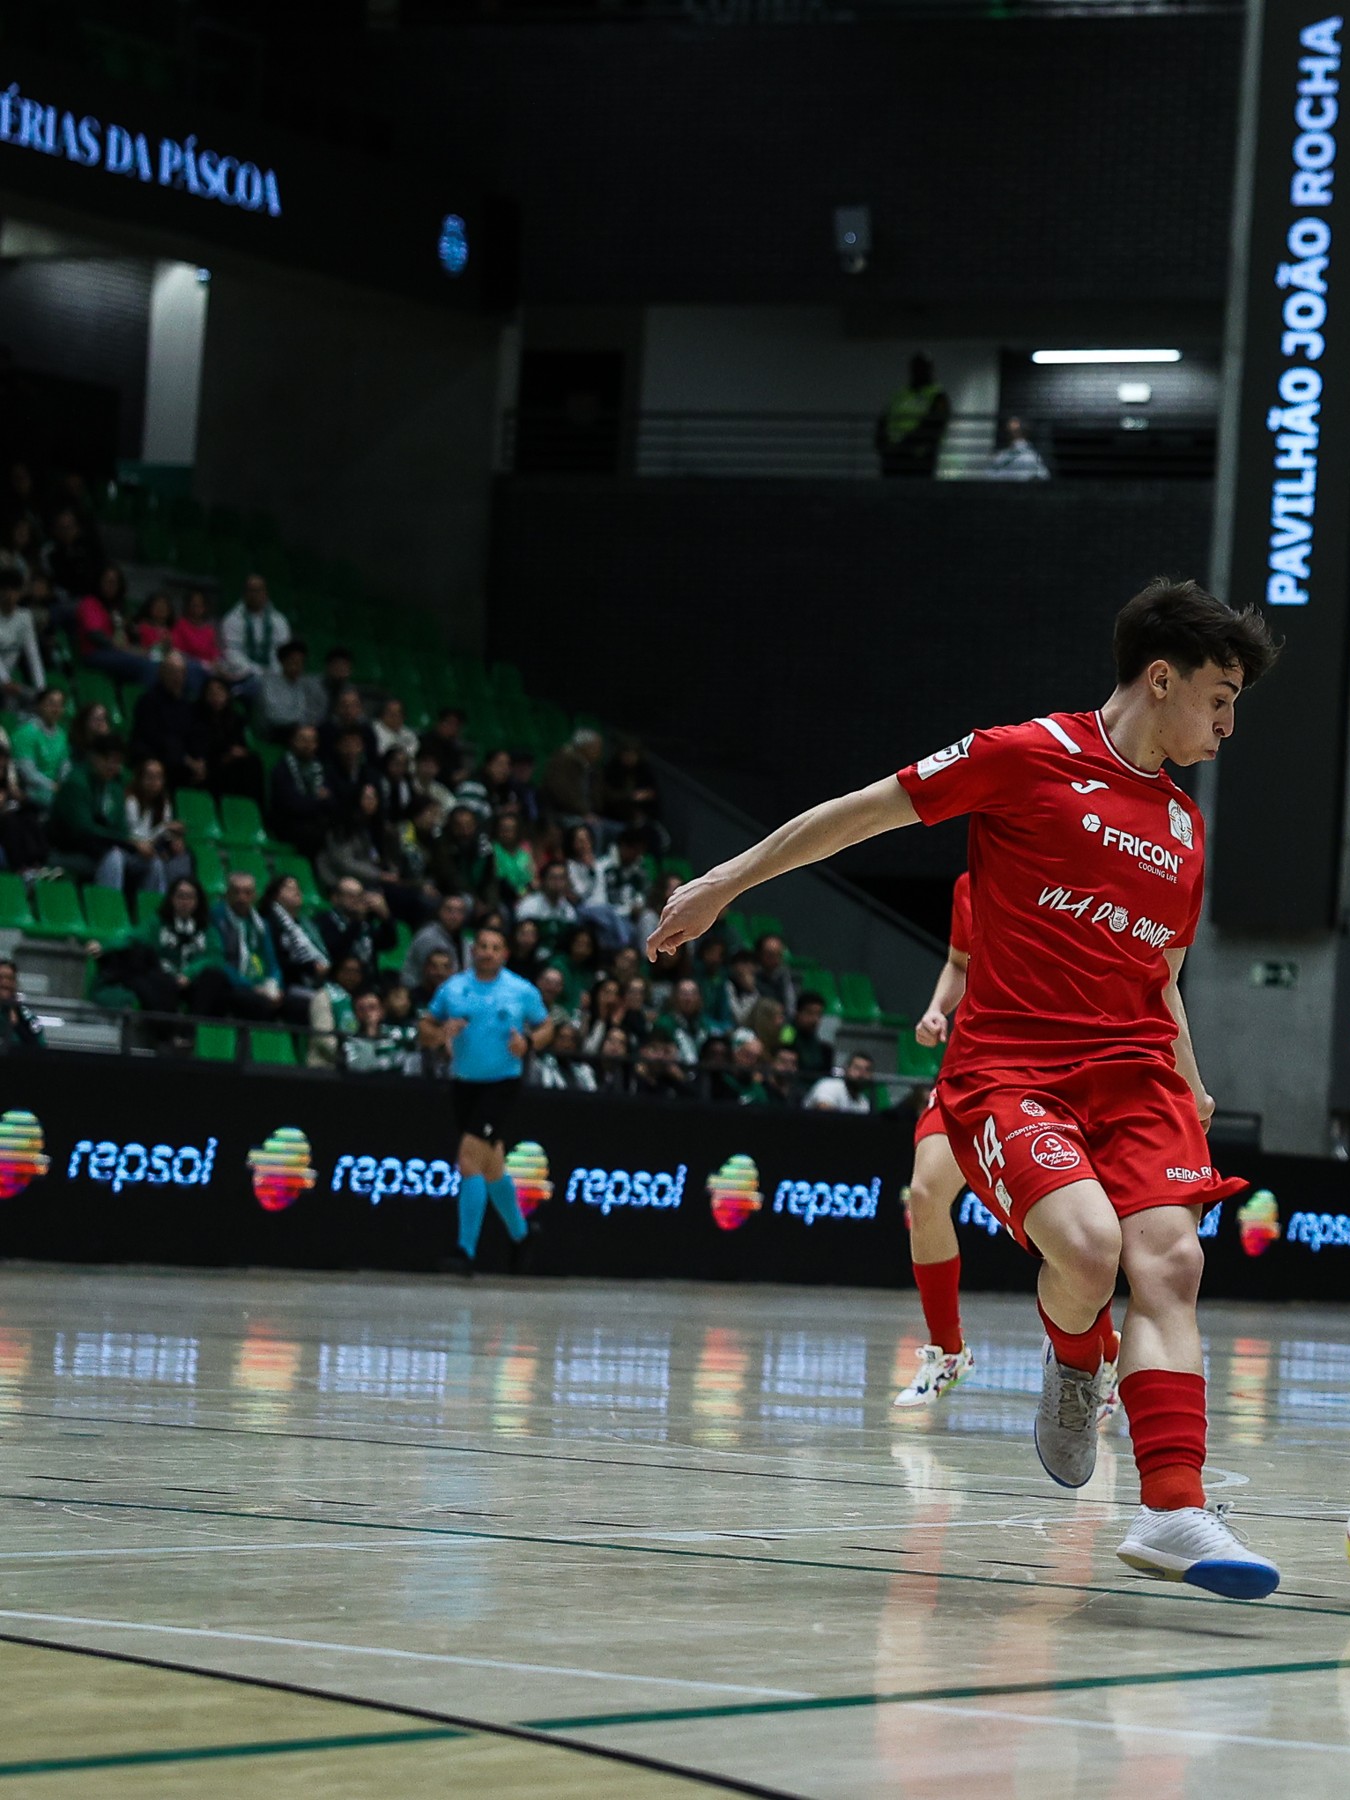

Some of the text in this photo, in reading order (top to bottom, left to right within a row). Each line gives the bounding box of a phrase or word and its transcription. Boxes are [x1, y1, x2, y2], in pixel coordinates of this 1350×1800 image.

[104, 123, 152, 184] DA
[158, 133, 282, 218] PÁSCOA
[1265, 15, 1344, 606] PAVILHÃO JOÃO ROCHA
[1102, 826, 1178, 874] FRICON
[1138, 861, 1178, 884] COOLING LIFE
[1038, 886, 1094, 918] VILA
[1131, 917, 1176, 948] CONDE
[67, 1137, 218, 1193] repsol
[565, 1163, 687, 1215] repsol
[1166, 1167, 1201, 1180] BEIRA
[773, 1176, 881, 1226] repsol
